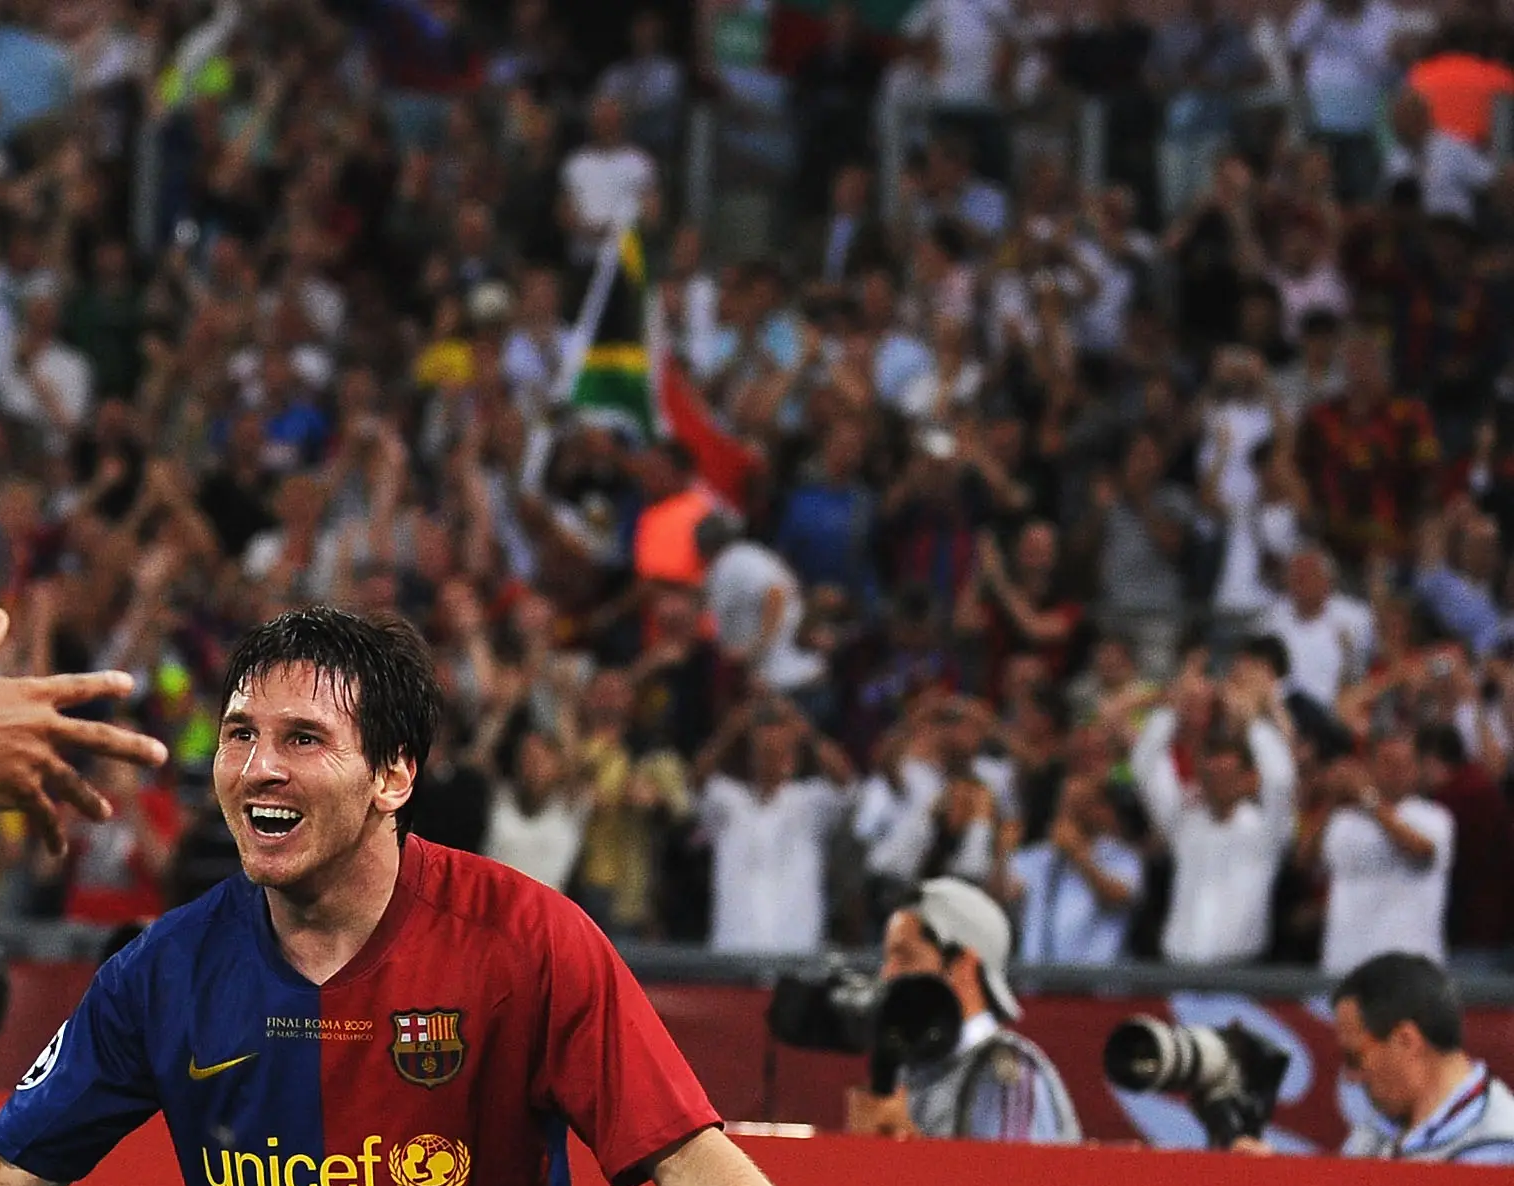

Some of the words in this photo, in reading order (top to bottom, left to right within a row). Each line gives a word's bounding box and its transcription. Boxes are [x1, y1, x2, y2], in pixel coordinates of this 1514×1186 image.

[266, 1016, 301, 1028] FINAL
[305, 1017, 341, 1030] ROMA
[344, 1019, 373, 1031] 2009
[415, 1041, 442, 1051] FCB
